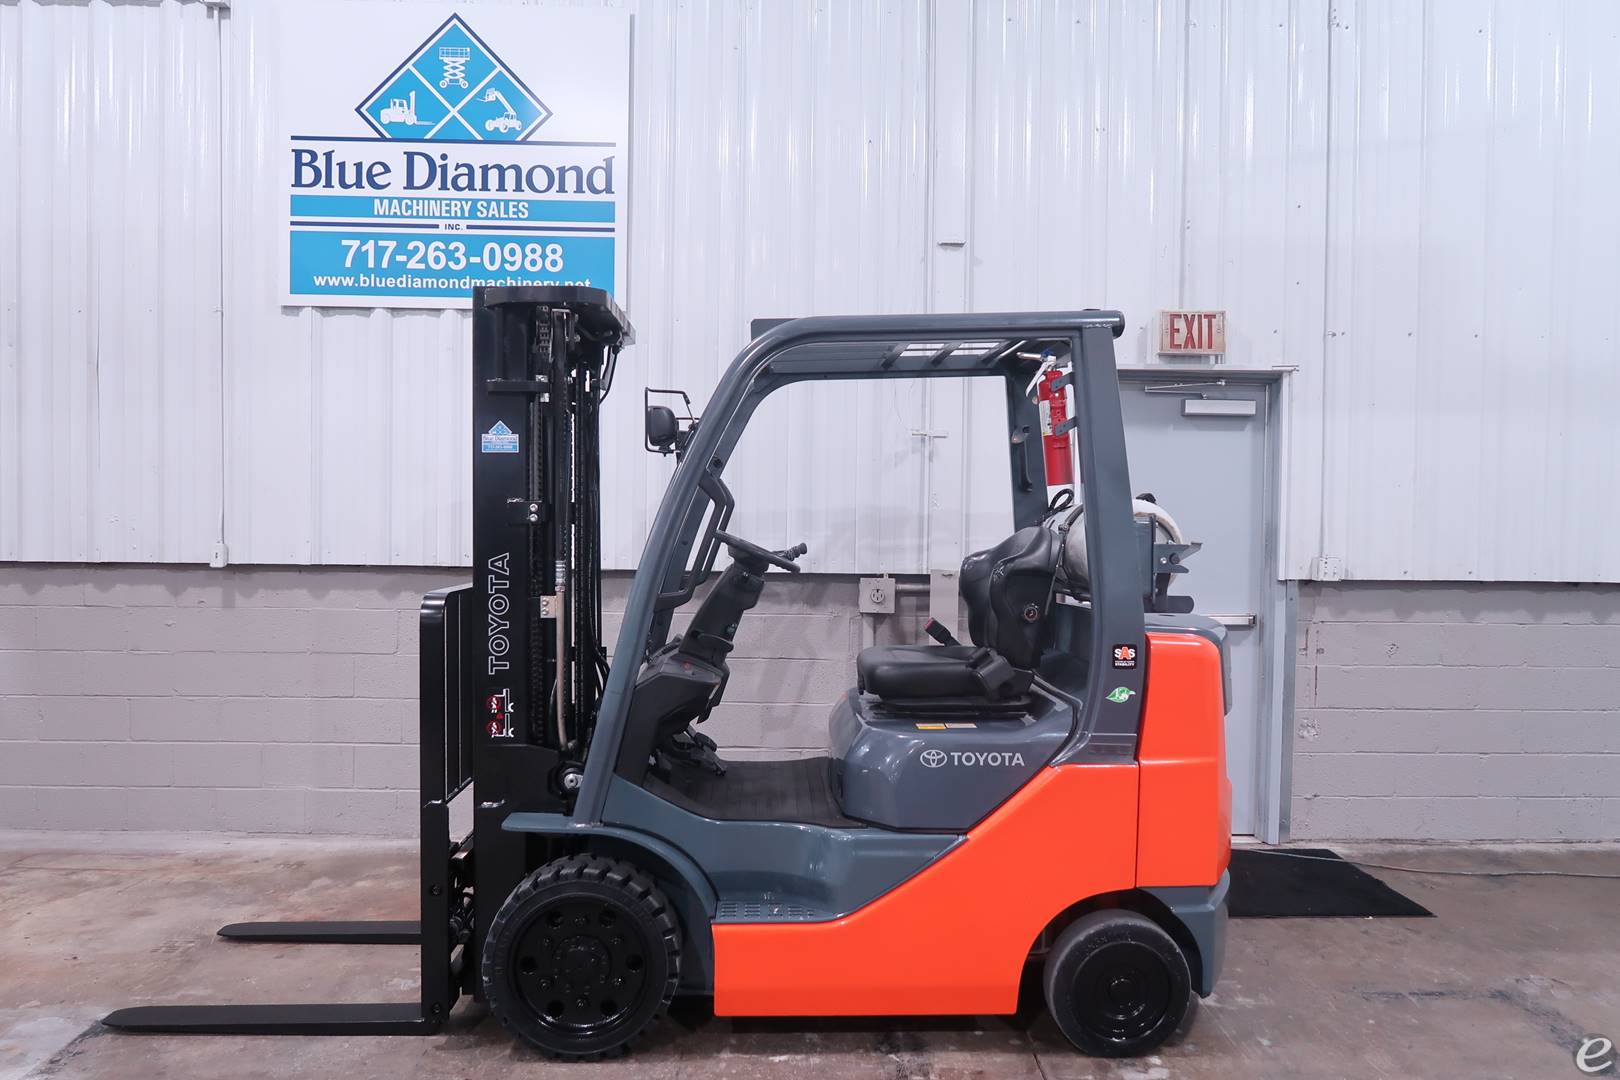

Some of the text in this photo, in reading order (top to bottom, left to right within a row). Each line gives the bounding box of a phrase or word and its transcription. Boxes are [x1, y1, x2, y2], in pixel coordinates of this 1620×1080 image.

[291, 149, 615, 194] Blue Diamond
[373, 198, 529, 219] MACHINERY SALES
[444, 223, 463, 231] INC.
[341, 239, 564, 273] 717-263-0988
[313, 273, 591, 289] www.bluediamondmachinernet
[1169, 313, 1217, 350] EXIT
[488, 552, 510, 675] TOYOTA
[1114, 646, 1135, 660] SAS
[951, 752, 1025, 767] TOYOTA
